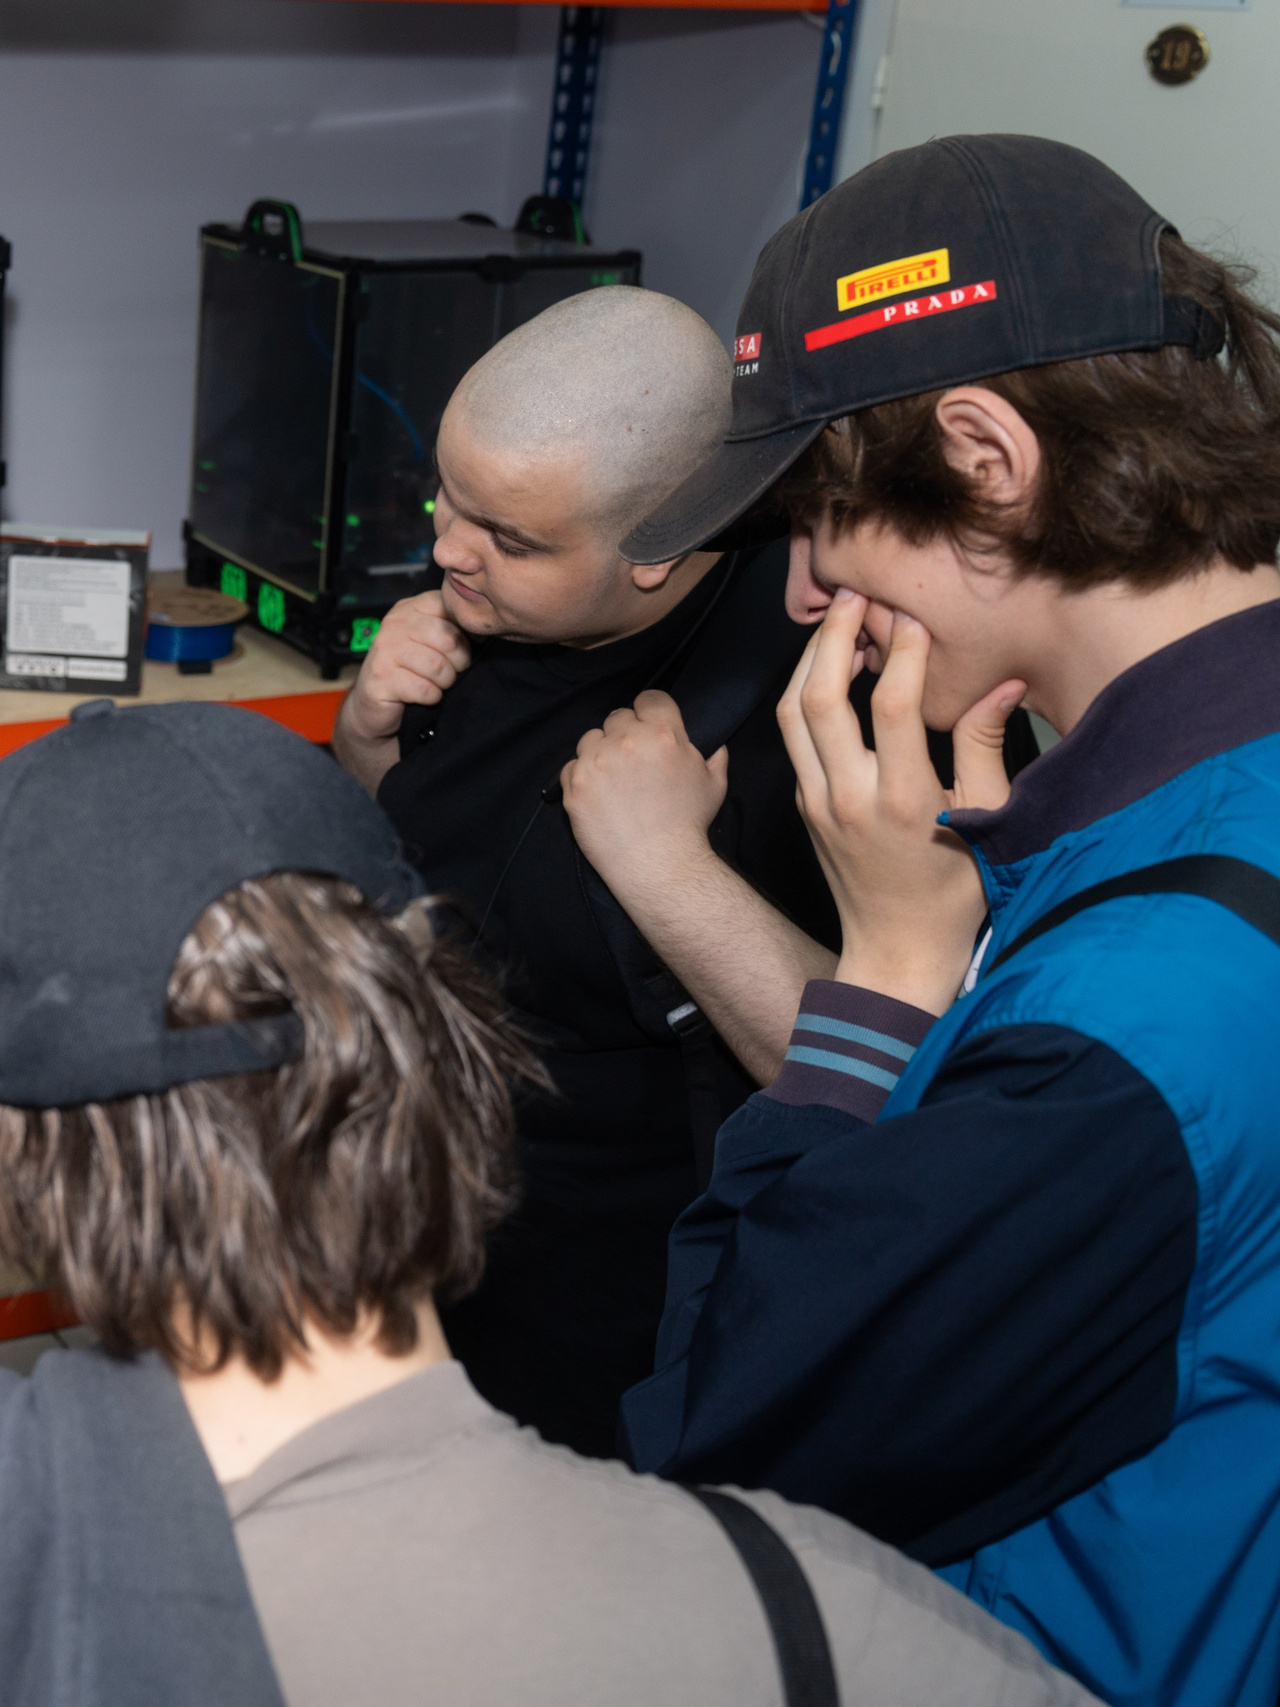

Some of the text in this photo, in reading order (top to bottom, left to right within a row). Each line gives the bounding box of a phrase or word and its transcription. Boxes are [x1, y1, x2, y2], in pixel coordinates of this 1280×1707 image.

[846, 259, 937, 302] PIRELLI
[883, 284, 989, 321] PRADA
[736, 362, 759, 377] TEAM
